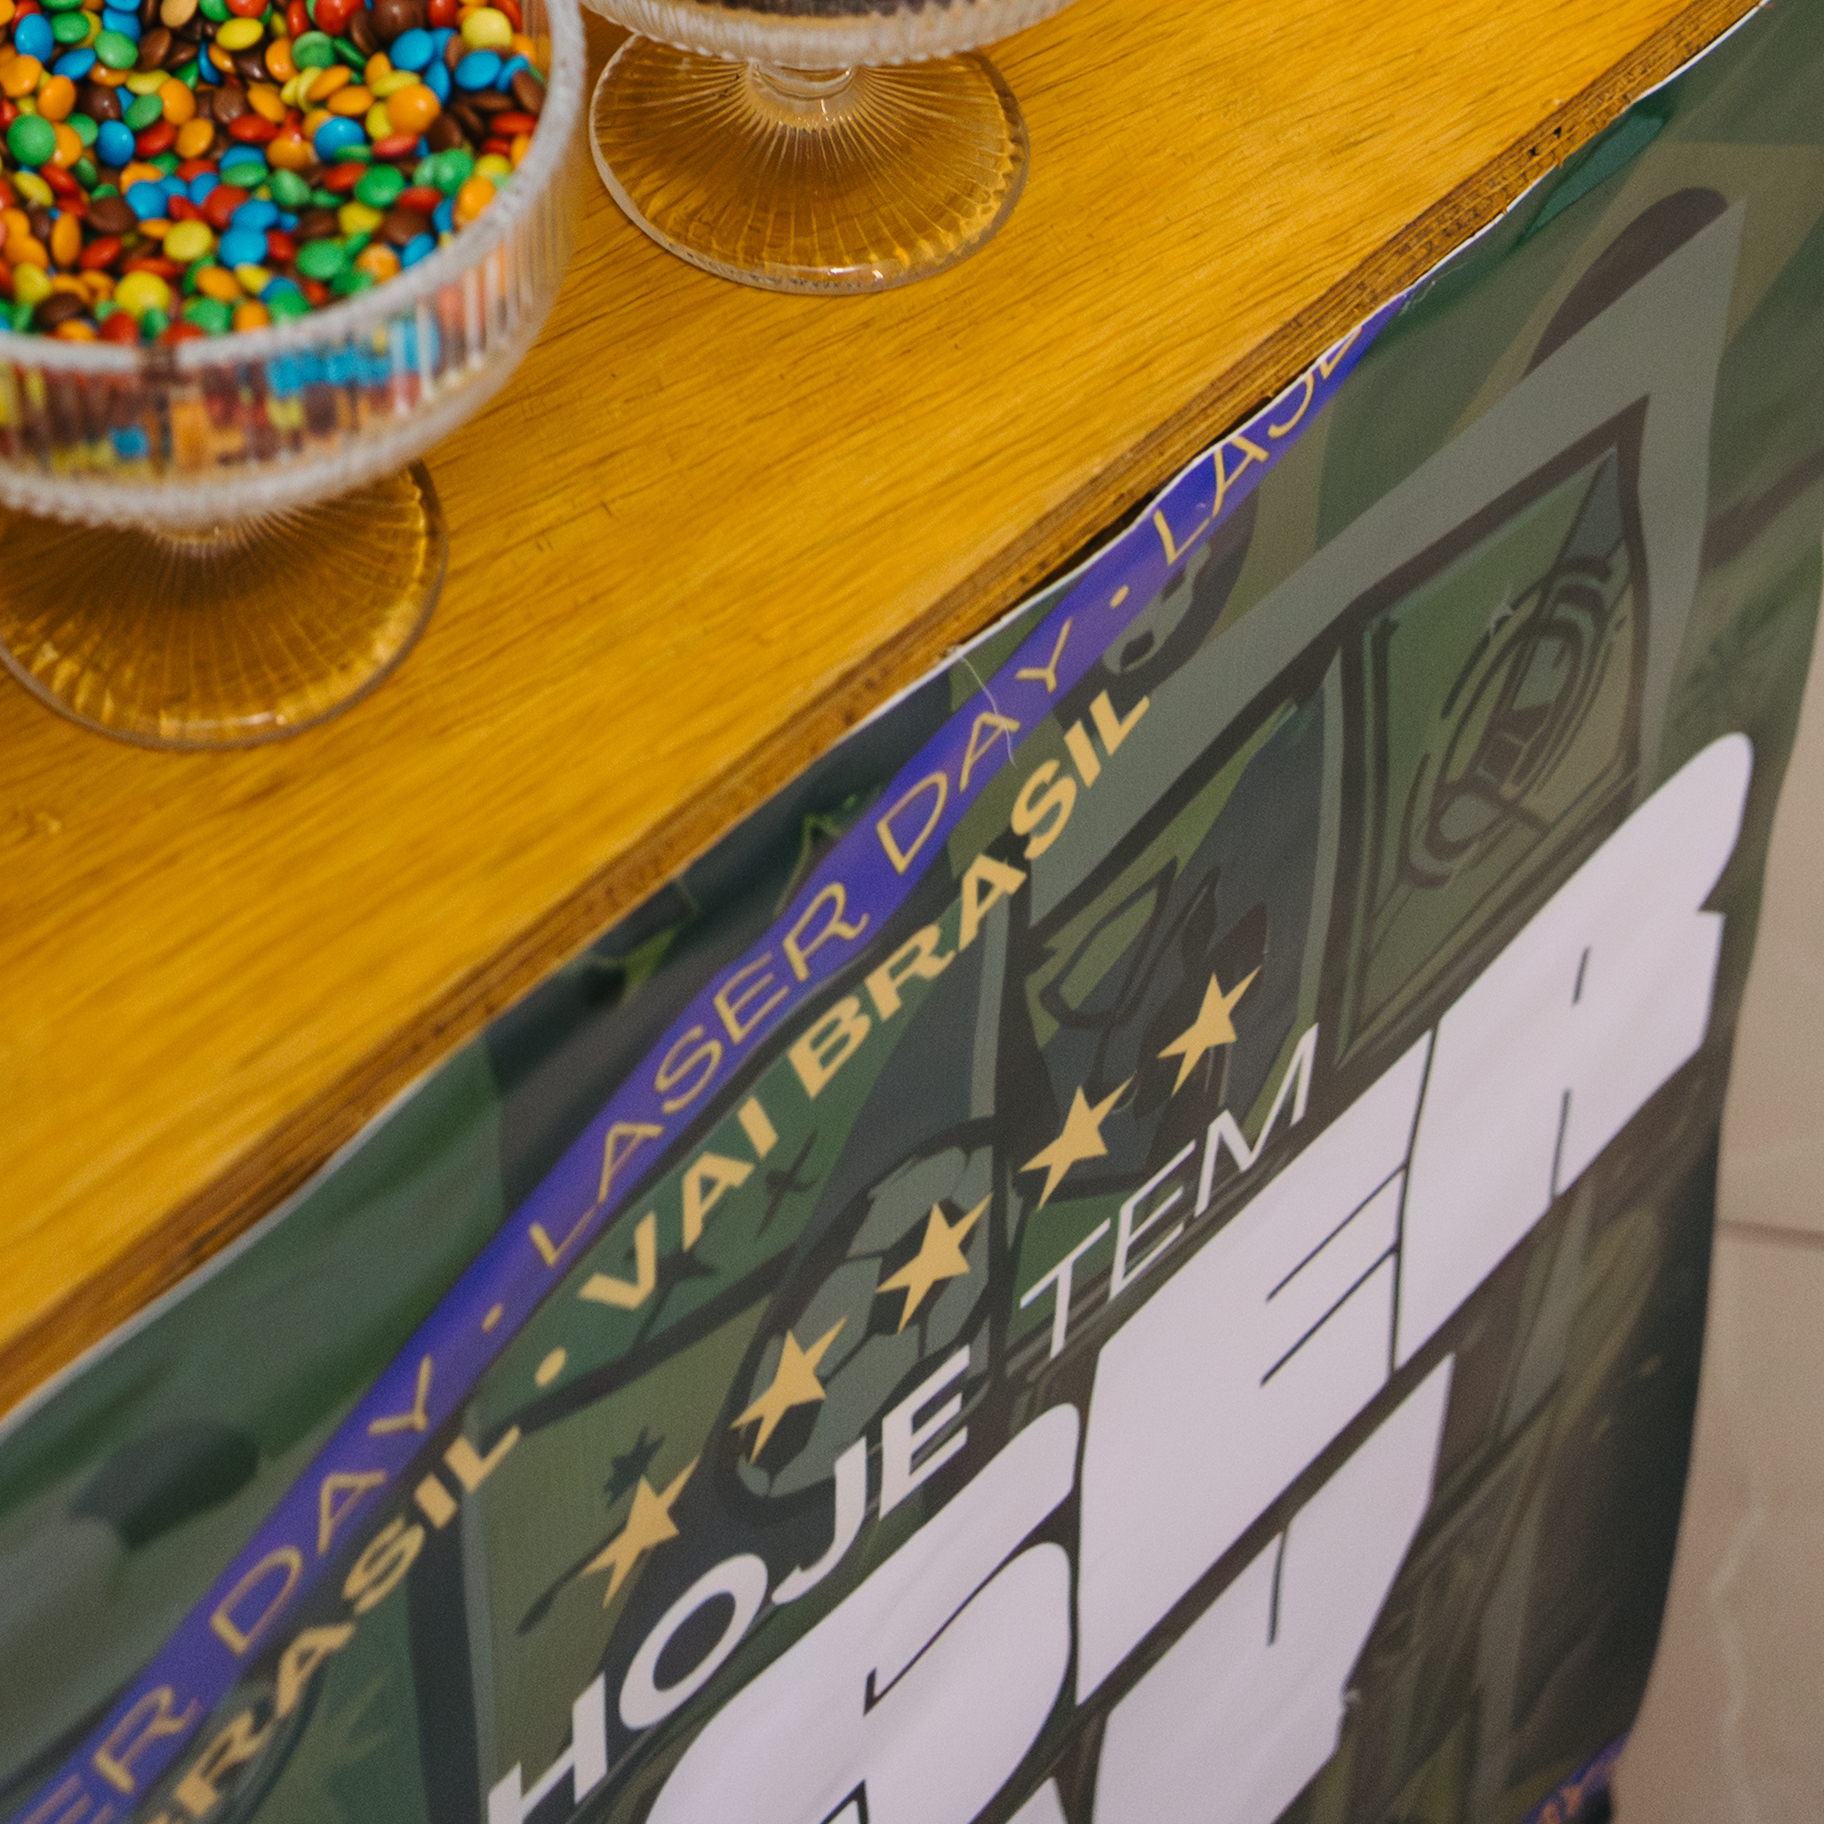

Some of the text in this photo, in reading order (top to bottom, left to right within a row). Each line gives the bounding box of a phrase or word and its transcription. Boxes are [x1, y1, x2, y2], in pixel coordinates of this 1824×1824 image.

[144, 689, 1151, 1824] RASIL VAI BRASIL
[210, 1355, 432, 1656] DAY
[528, 881, 870, 1268] LASER
[875, 616, 1073, 876] DAY
[486, 1342, 971, 1824] HOJE
[1018, 1021, 1321, 1360] TEM
